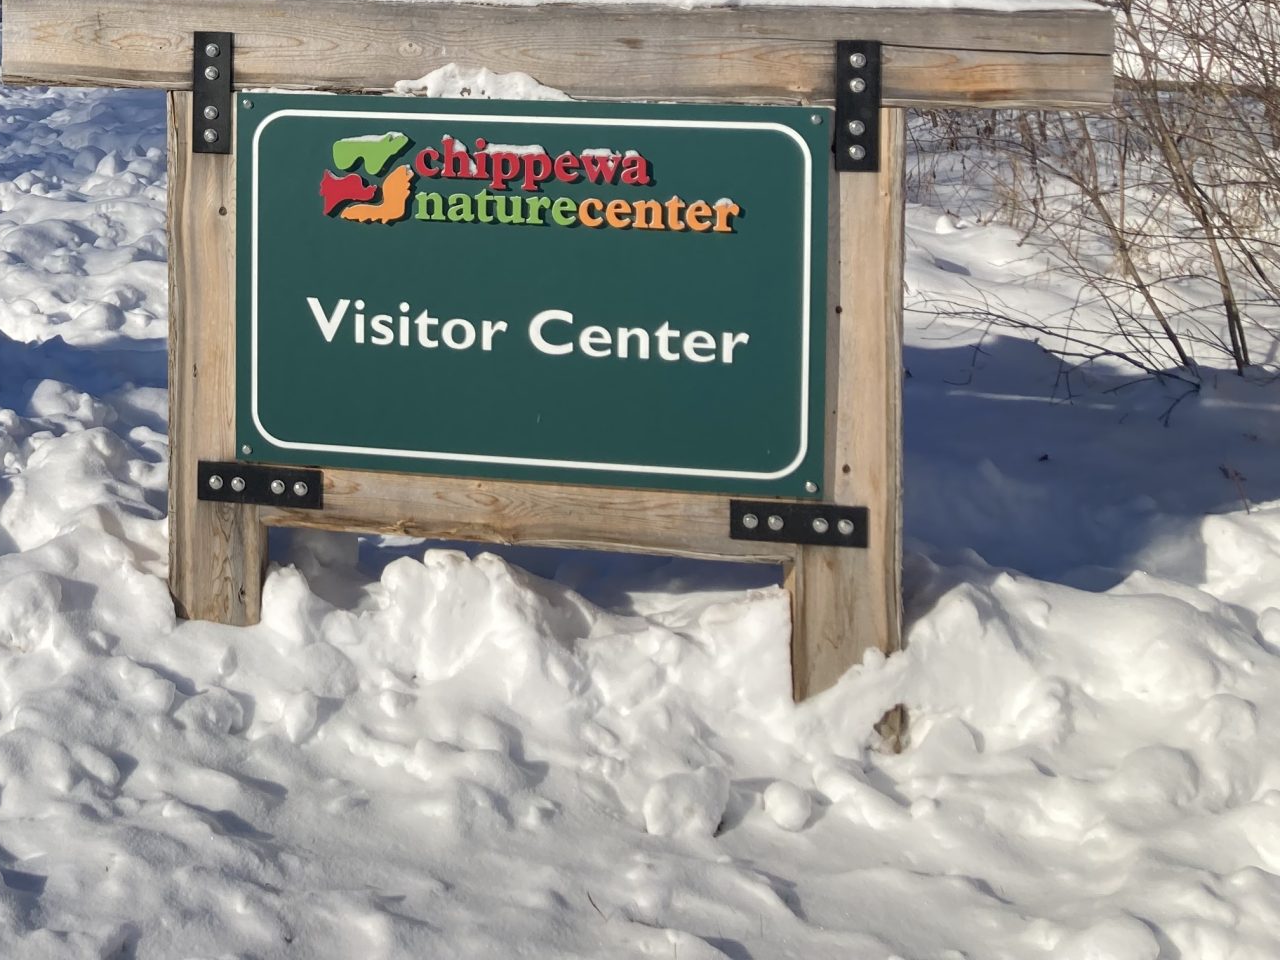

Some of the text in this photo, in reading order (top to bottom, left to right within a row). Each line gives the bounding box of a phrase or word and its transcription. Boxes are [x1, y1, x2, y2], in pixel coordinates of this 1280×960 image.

[414, 135, 650, 190] chippewa
[414, 193, 740, 232] naturecenter
[306, 297, 750, 363] Visitor Center
